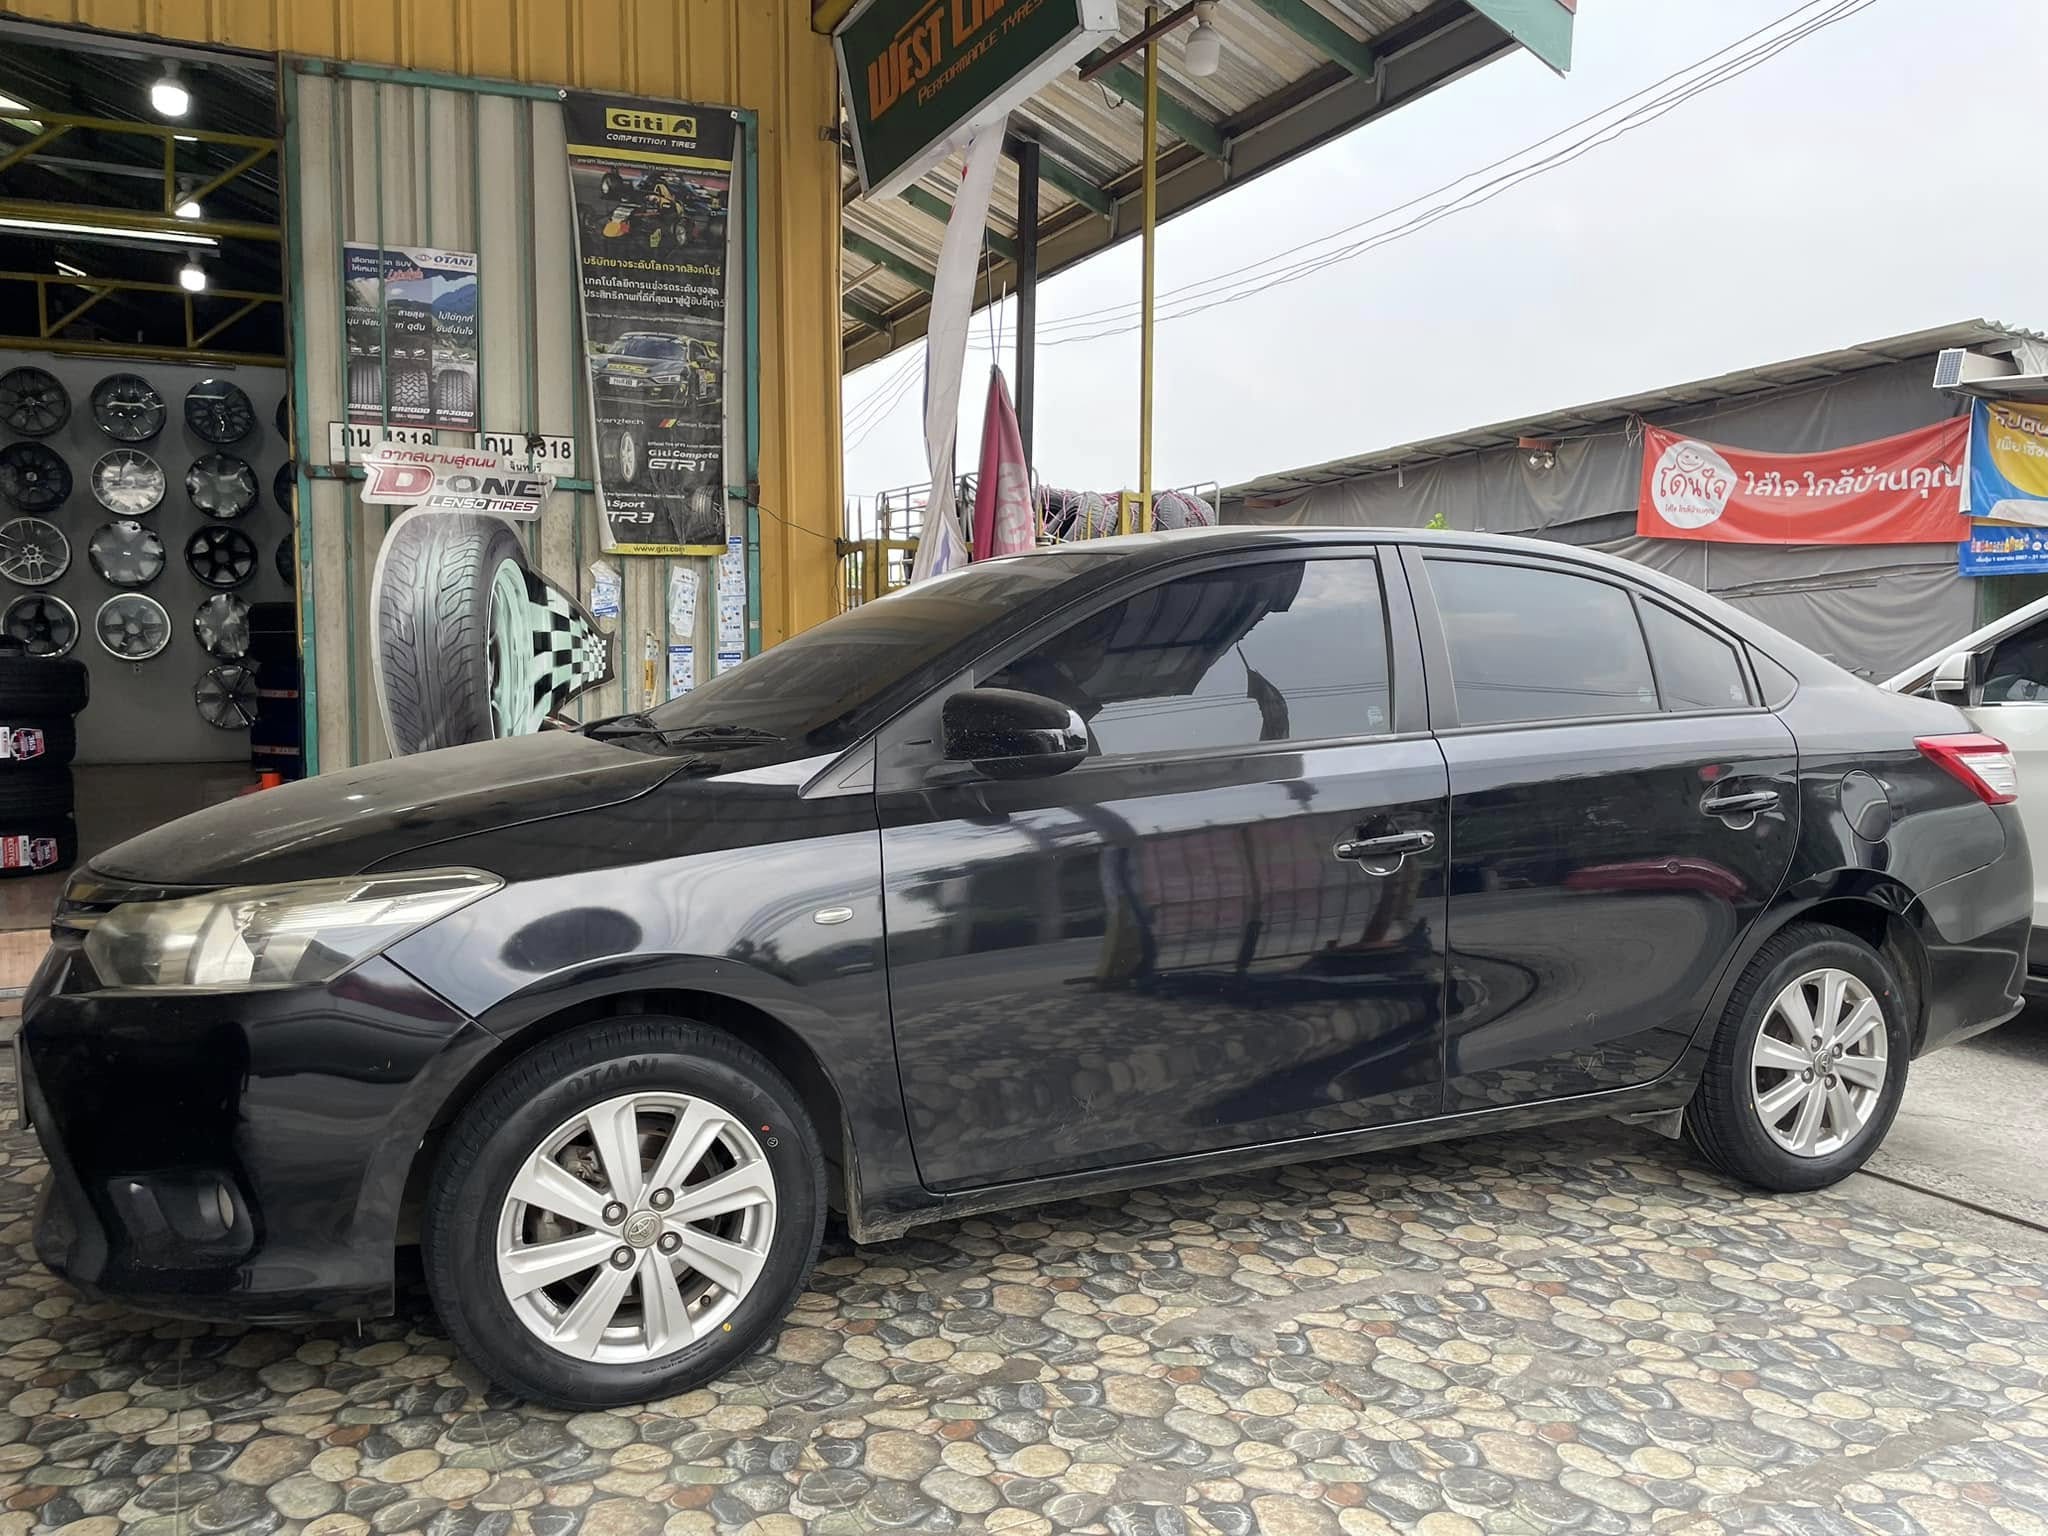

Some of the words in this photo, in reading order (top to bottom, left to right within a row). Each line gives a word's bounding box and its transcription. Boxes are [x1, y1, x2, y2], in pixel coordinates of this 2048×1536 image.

[867, 6, 945, 121] WEST
[917, 28, 999, 107] PERFORMANCE
[612, 113, 663, 131] Giti
[606, 133, 666, 146] COMPETITION
[671, 139, 697, 150] TIRES
[433, 255, 473, 267] OTANI
[380, 449, 497, 470] จากสนามสู่ถนน
[648, 449, 672, 458] Giti
[673, 450, 720, 461] Compete
[1660, 464, 1727, 500] โดนใจ
[1743, 470, 1800, 497] ใส่ใจ
[1803, 463, 1963, 500] ใกล้บ้านคุณ
[429, 495, 487, 509] LENSO
[488, 499, 540, 512] TIRES
[611, 500, 646, 510] Sport
[607, 510, 655, 524] TR3
